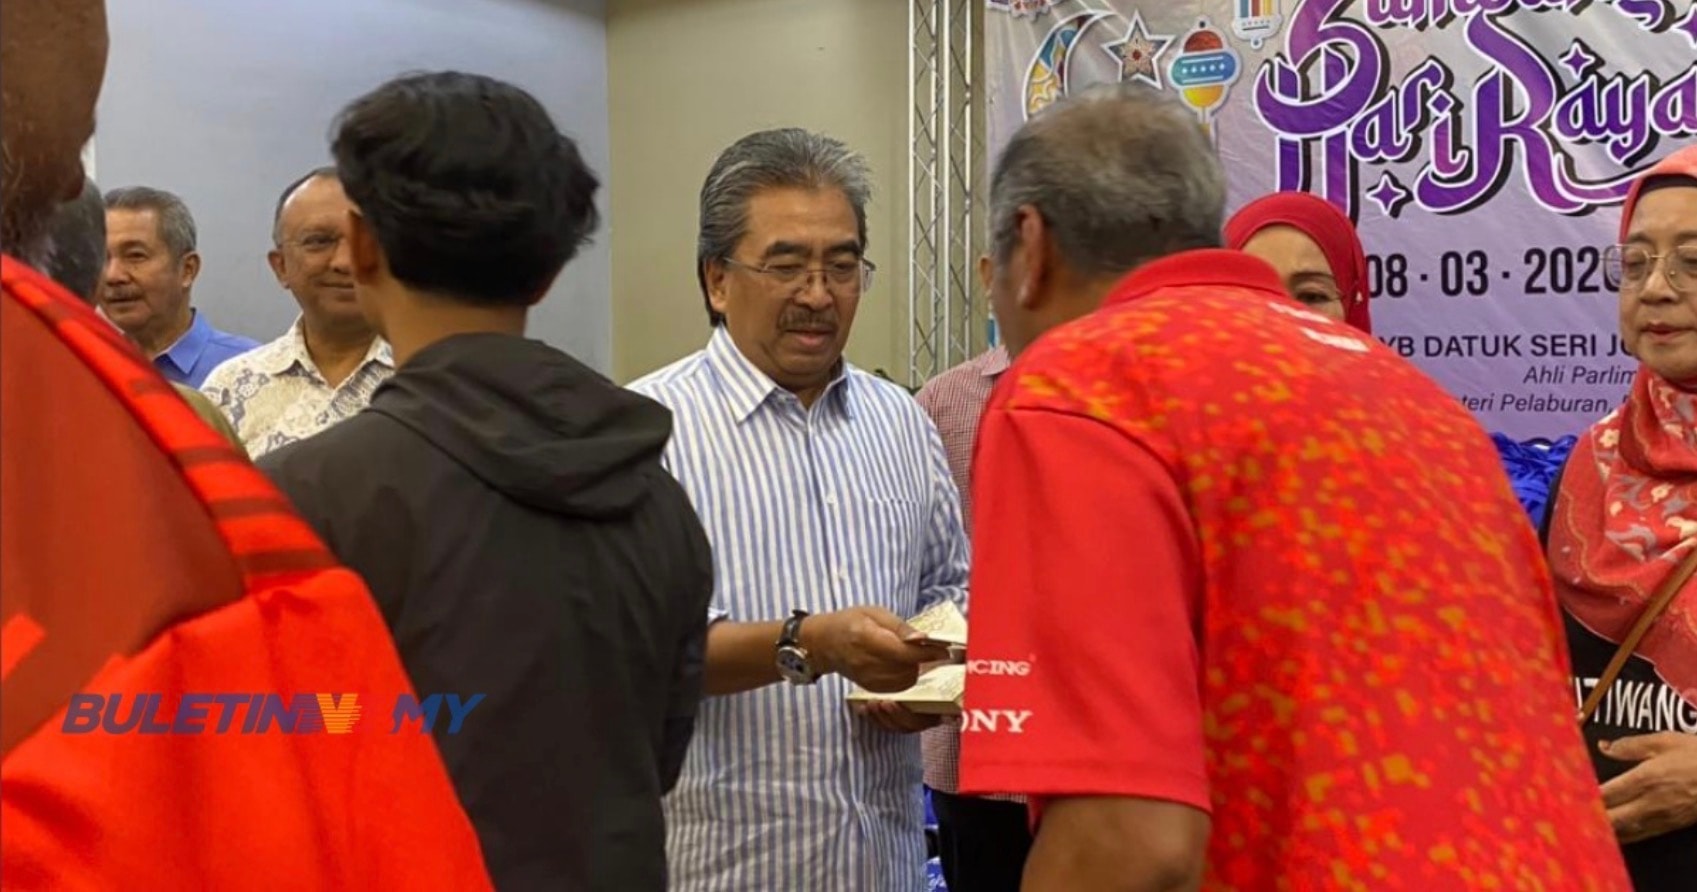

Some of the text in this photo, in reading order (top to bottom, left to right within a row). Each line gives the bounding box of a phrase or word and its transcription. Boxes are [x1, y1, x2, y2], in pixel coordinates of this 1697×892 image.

[1253, 0, 1697, 222] Hari Raya
[1365, 253, 1408, 298] 08
[1440, 250, 1489, 297] 03
[1424, 335, 1522, 357] DATUK
[1530, 334, 1597, 356] SERI
[1523, 366, 1565, 385] Ahli
